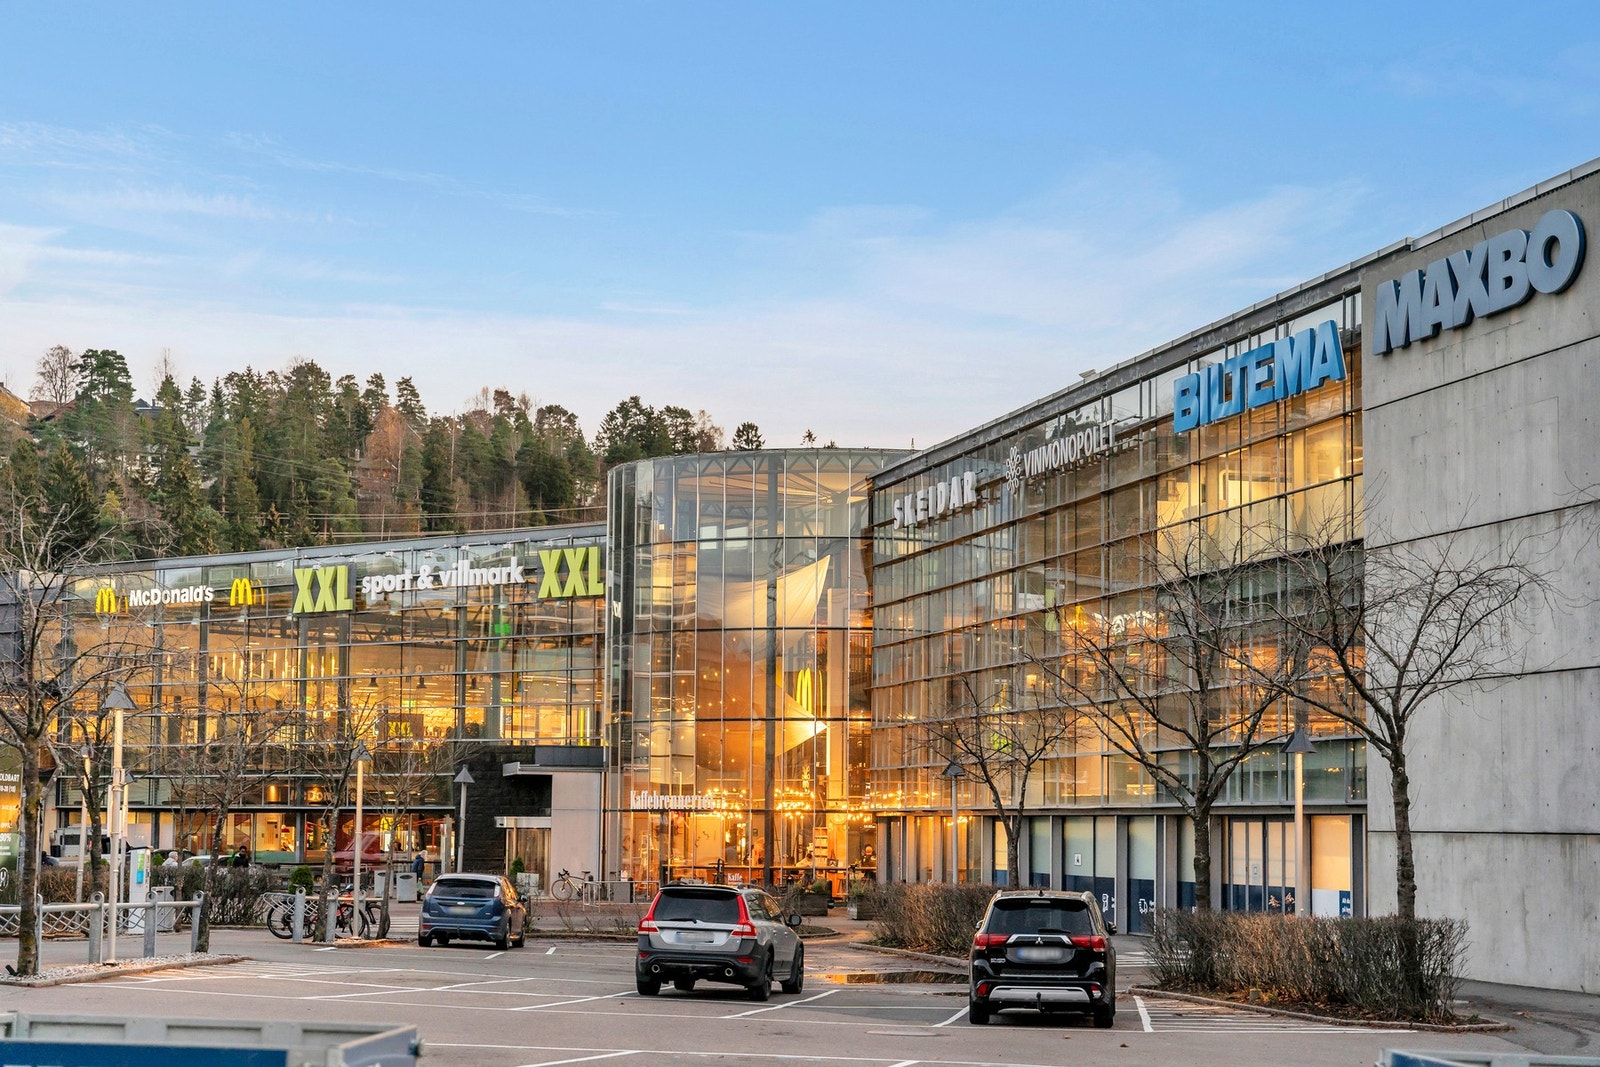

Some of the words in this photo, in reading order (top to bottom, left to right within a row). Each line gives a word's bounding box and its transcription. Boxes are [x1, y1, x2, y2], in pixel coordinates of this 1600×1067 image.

[1372, 209, 1586, 355] MAXBO
[1174, 320, 1346, 433] BILTEMA
[1024, 419, 1115, 477] VINMONOPOLET
[894, 471, 976, 529] SKEIDAR
[129, 585, 214, 607] McDonald's
[293, 565, 353, 613] XXL
[361, 571, 413, 599] sport
[417, 564, 434, 589] &
[439, 557, 525, 587] villmark
[538, 546, 604, 598] XXL
